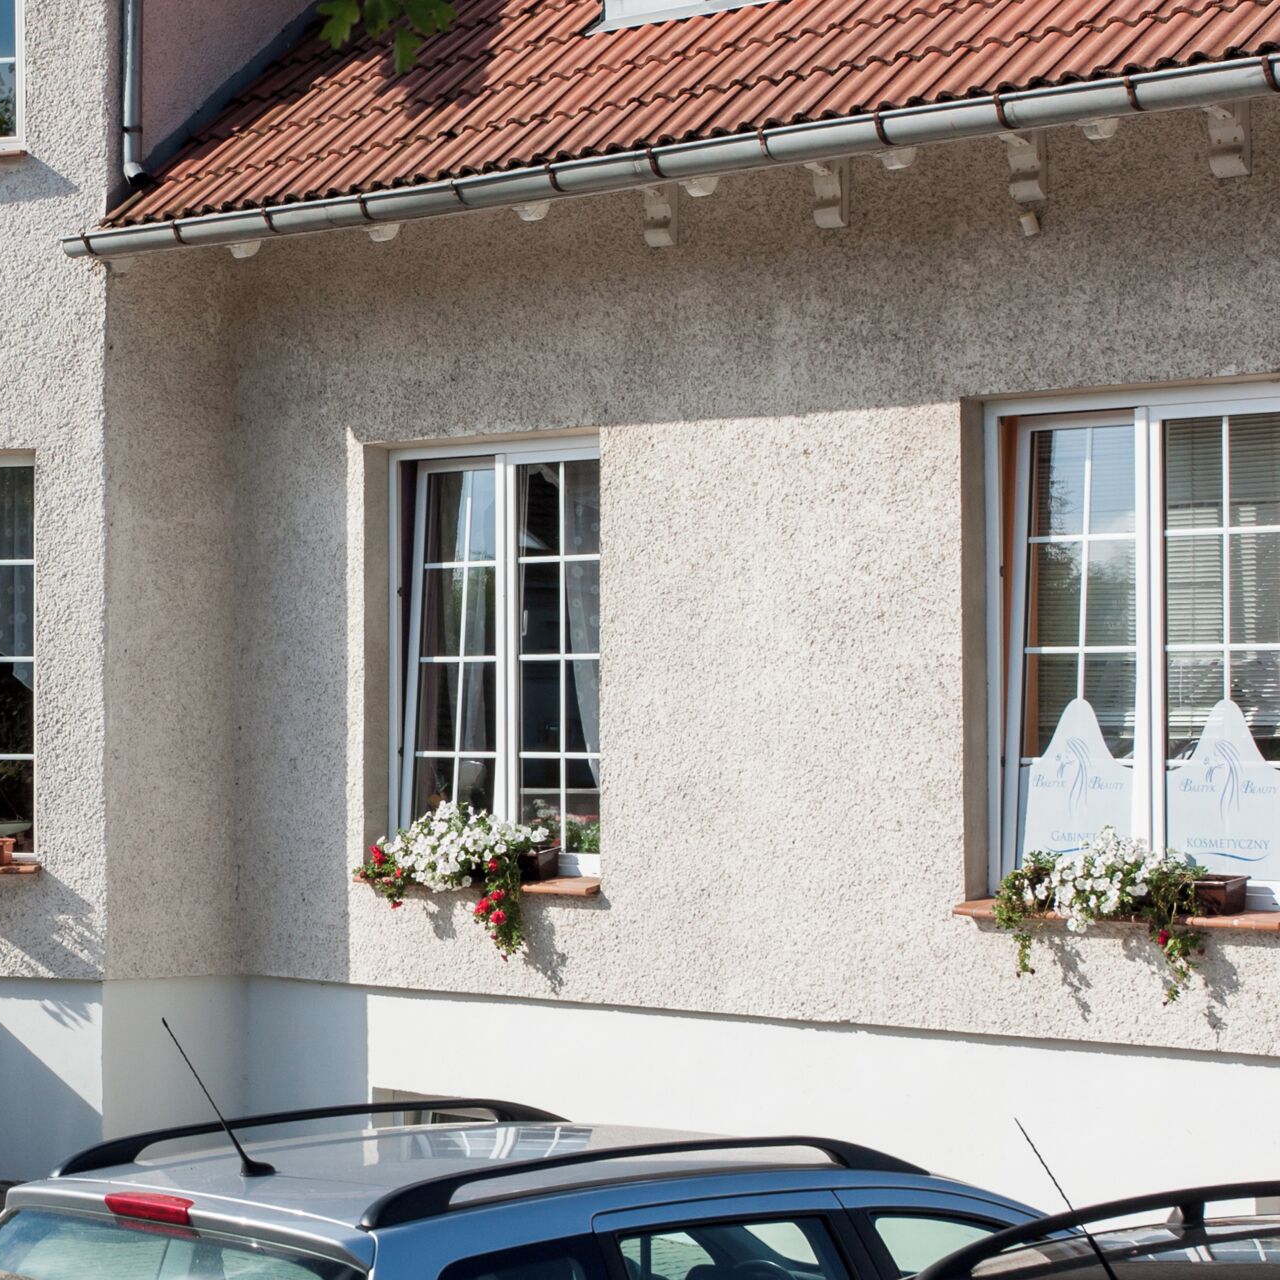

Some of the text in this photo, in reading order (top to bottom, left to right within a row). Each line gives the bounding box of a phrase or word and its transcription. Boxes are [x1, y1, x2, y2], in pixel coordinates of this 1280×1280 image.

[1088, 775, 1124, 790] BEAUTY
[1242, 780, 1278, 795] BEAUTY
[1050, 830, 1097, 843] GABINET
[1186, 837, 1270, 851] KOSMETYCZNY
